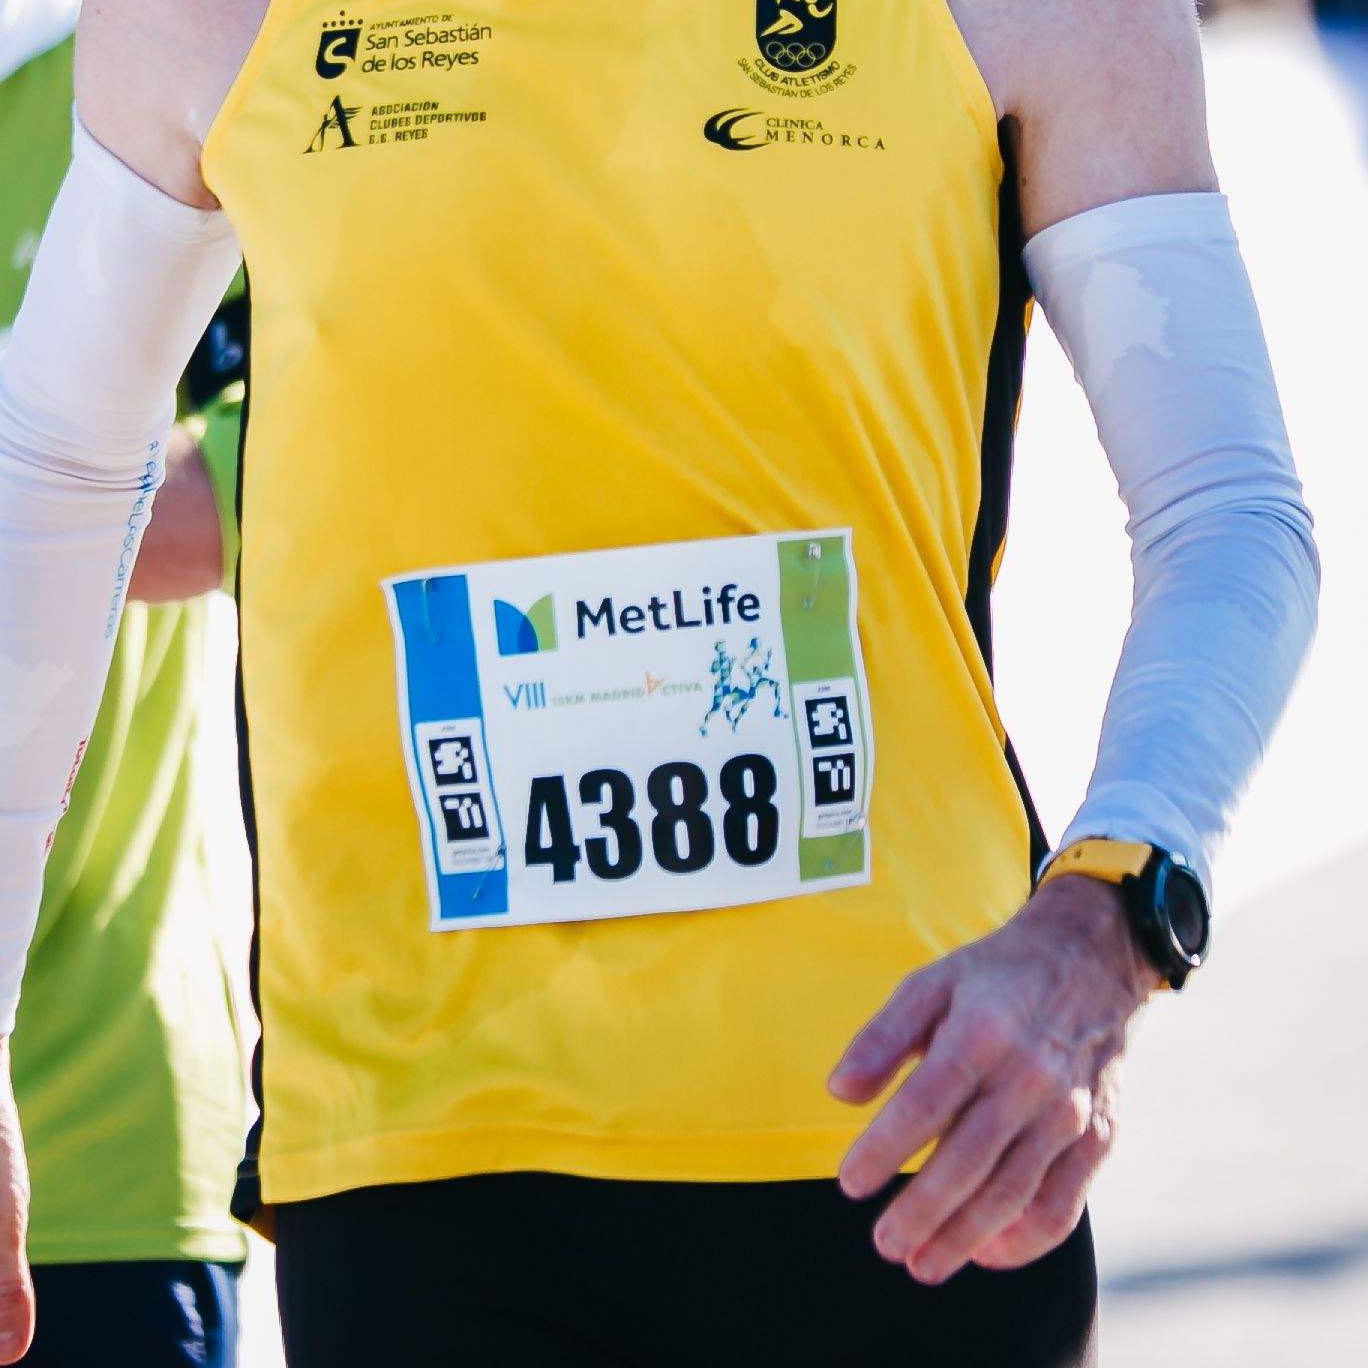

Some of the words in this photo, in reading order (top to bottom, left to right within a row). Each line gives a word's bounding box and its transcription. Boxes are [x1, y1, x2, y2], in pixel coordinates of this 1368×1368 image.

[369, 15, 439, 31] AYUNTAMIENTO
[441, 14, 453, 22] DE
[366, 34, 399, 51] San
[404, 22, 492, 47] Sebastián
[362, 56, 388, 73] de
[390, 54, 417, 71] los
[421, 51, 480, 72] Reyes
[754, 58, 780, 82] CLUB
[781, 60, 841, 87] ATLETISMO
[737, 57, 750, 75] SAN
[800, 88, 814, 99] DE
[816, 82, 835, 96] LOS
[833, 63, 858, 88] REYES
[369, 116, 411, 131] CLUBES
[415, 112, 487, 125] DEPORTIVOS
[766, 117, 824, 130] CLINICA
[395, 129, 429, 142] REYES
[765, 130, 886, 150] MENORCA
[575, 583, 761, 639] MetLife
[503, 682, 547, 711] VIII
[525, 753, 779, 885] 4388
